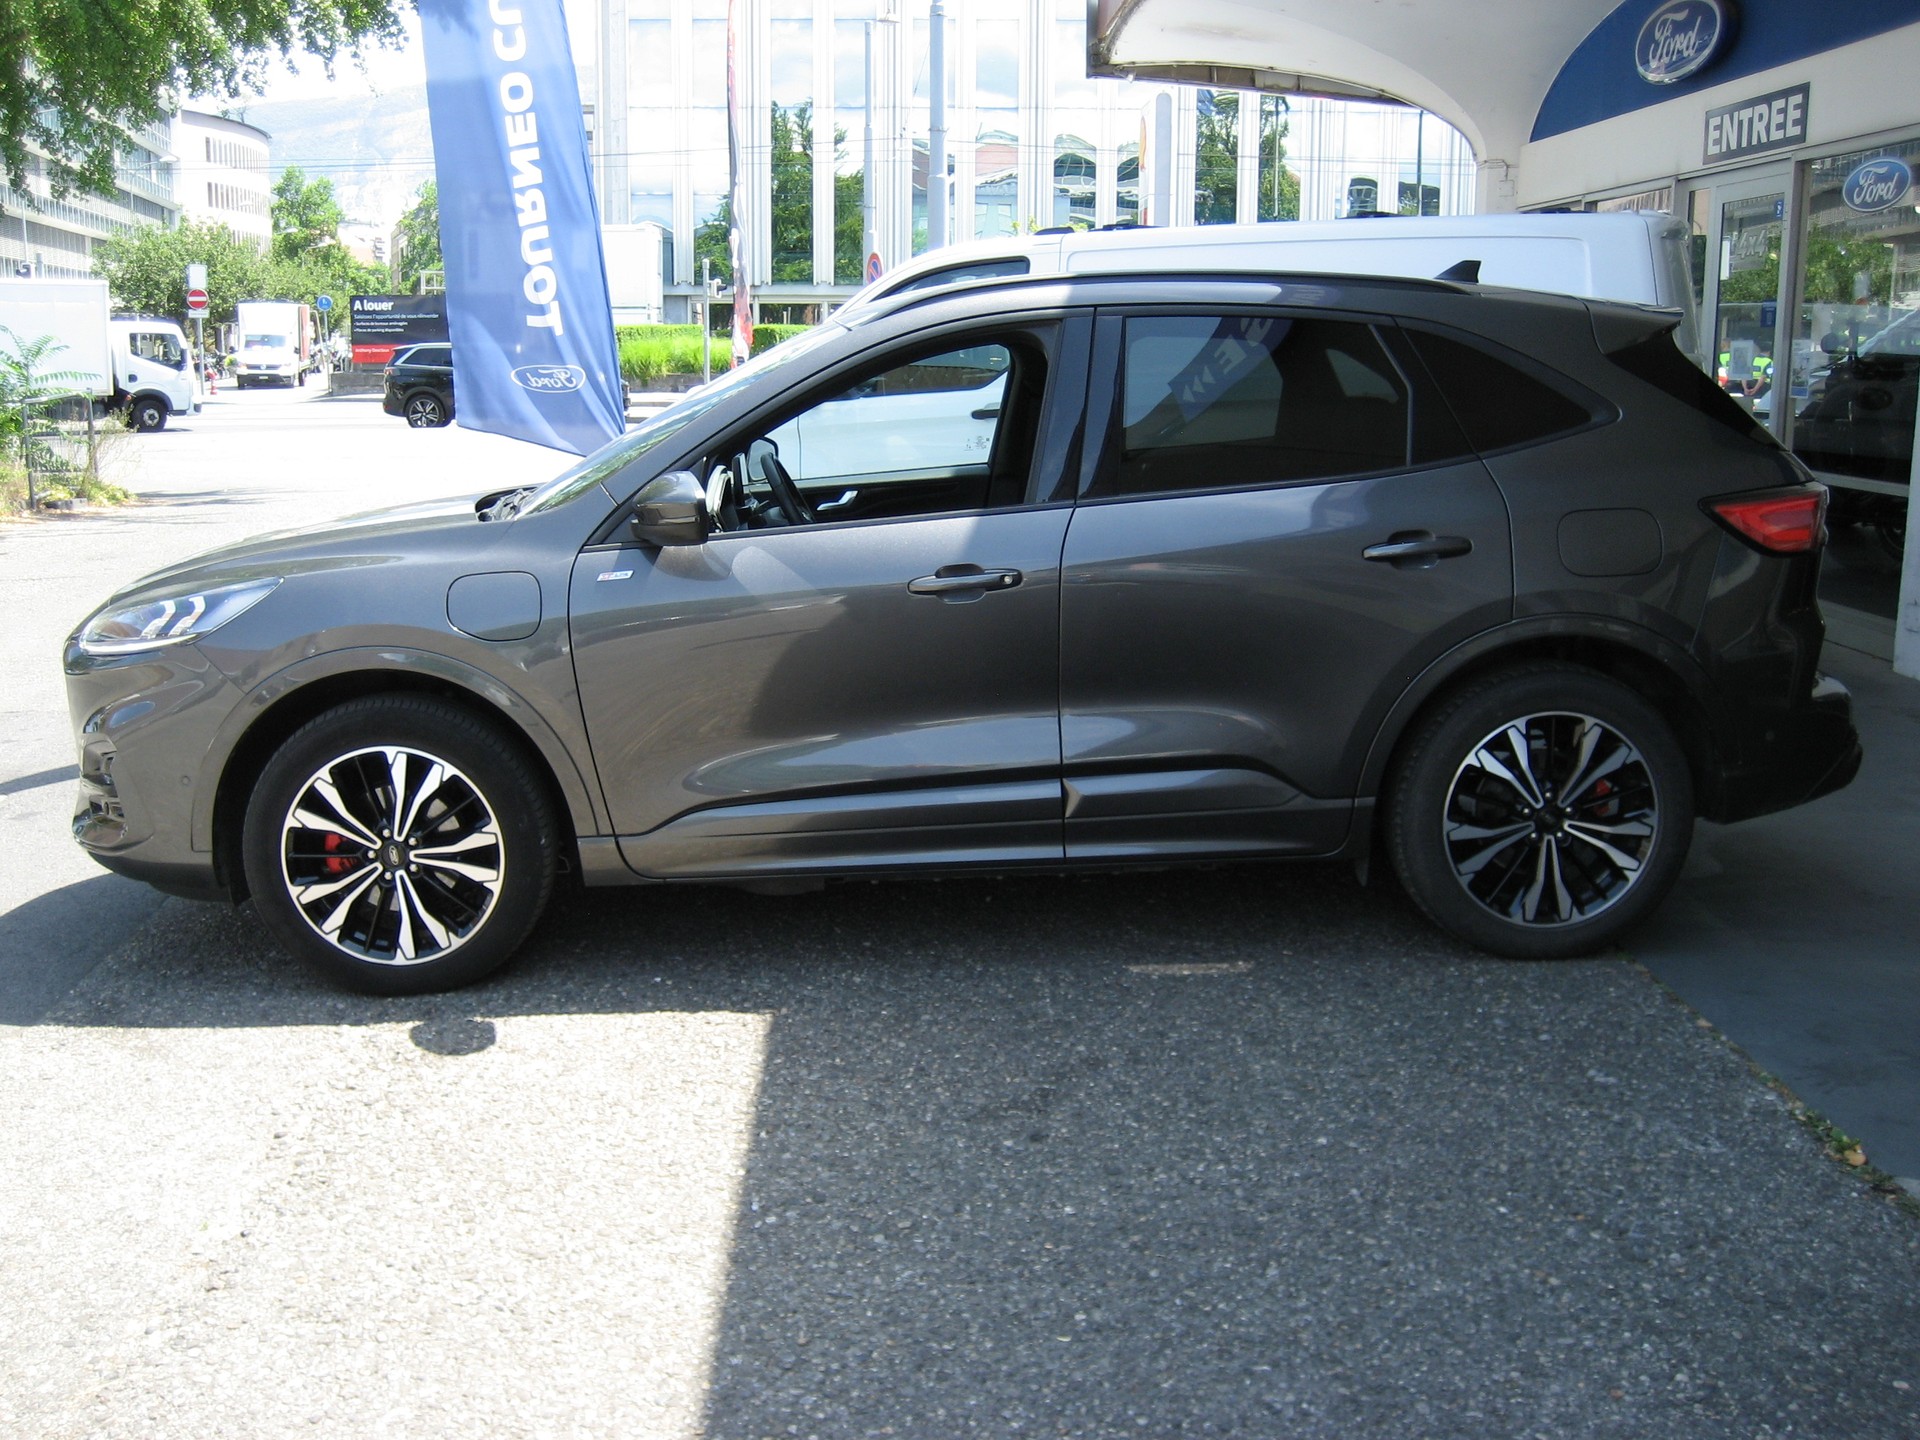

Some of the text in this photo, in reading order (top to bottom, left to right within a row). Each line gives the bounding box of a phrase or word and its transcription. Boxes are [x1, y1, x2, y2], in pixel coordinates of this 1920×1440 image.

[1648, 9, 1703, 69] Ford
[1707, 93, 1803, 155] ENTREE
[1853, 166, 1902, 204] Ford
[353, 299, 394, 311] A louer
